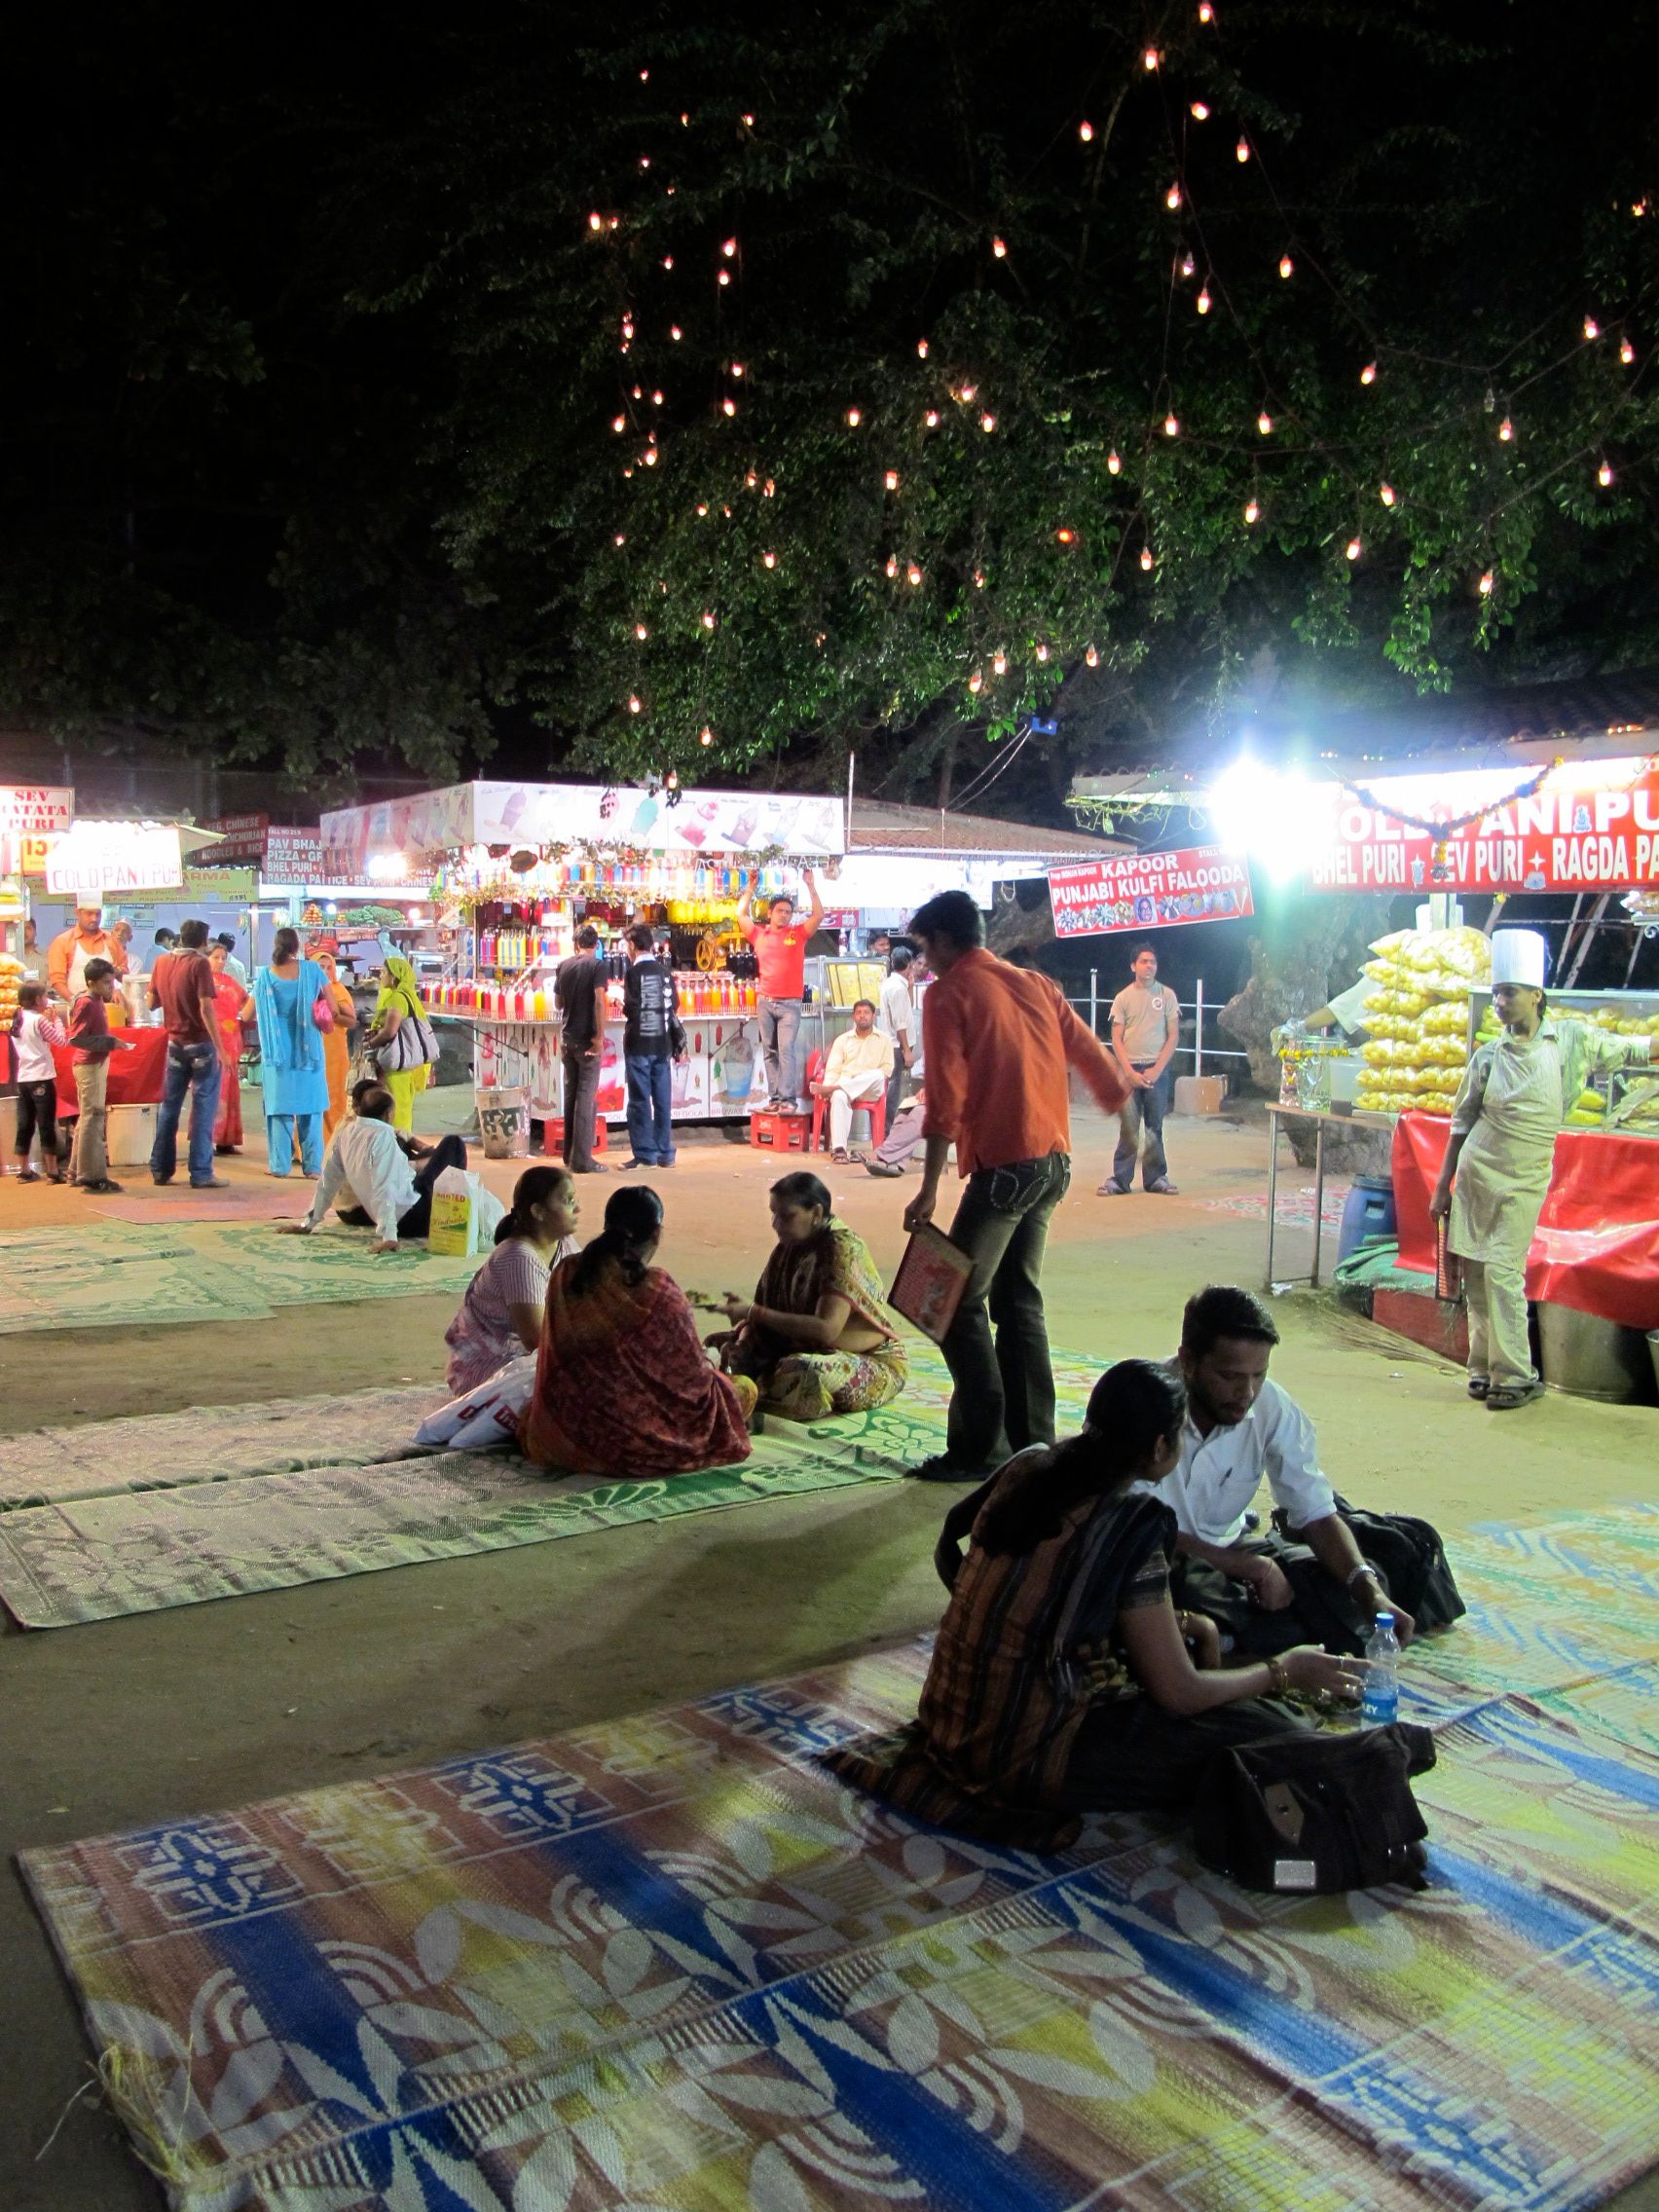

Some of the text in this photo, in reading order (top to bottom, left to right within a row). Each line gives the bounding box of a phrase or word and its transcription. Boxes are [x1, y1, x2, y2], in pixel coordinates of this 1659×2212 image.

[14, 791, 50, 802] SEV
[3, 805, 68, 816] ATATA
[226, 816, 260, 830] CHINESE
[247, 842, 264, 854] RICE
[268, 838, 322, 850] PAV BHAJ
[268, 850, 299, 861] PIZZA
[1363, 843, 1406, 884] PURI
[1475, 838, 1524, 883] PURI
[1552, 834, 1629, 881] RAGDA
[268, 861, 289, 872] BHEL
[292, 862, 313, 873] PURI
[1101, 854, 1179, 879] KAPOOR
[268, 872, 307, 884] RAGADA
[401, 875, 436, 887] CHINES
[1052, 864, 1245, 905] PUNJABI KULFI FALOODA
